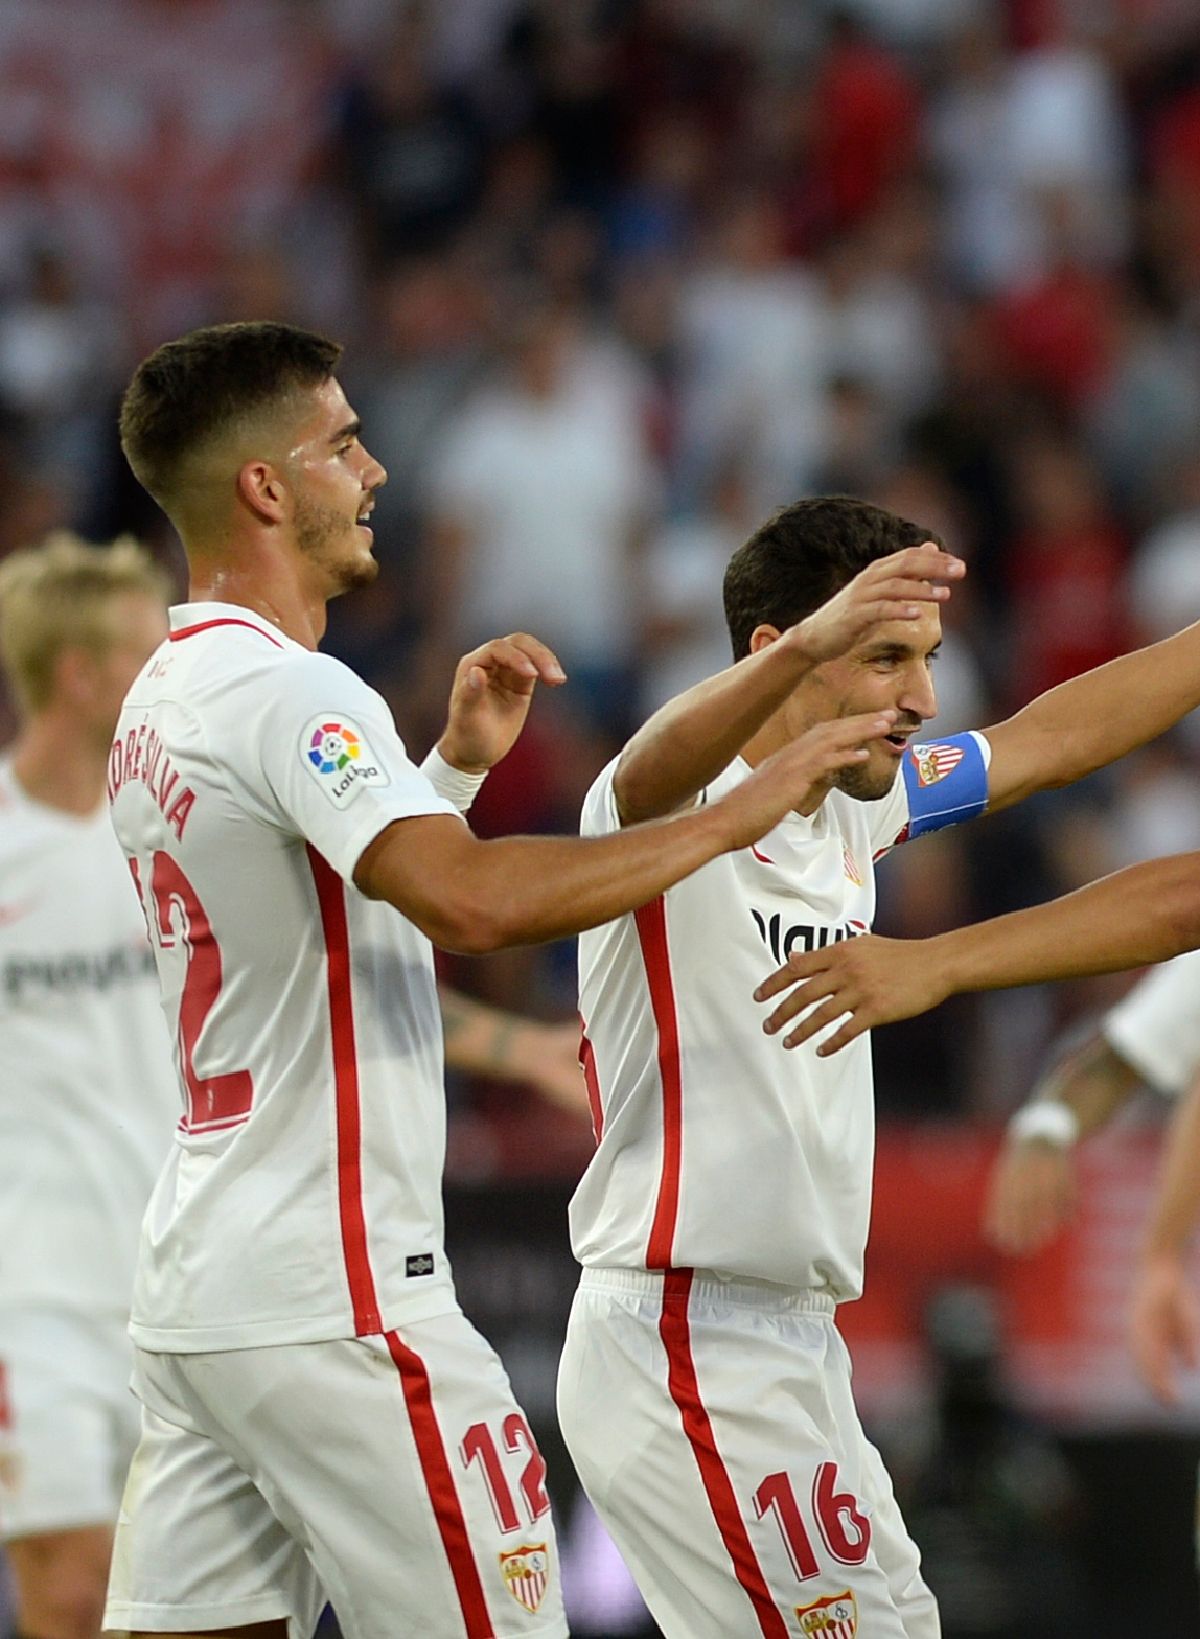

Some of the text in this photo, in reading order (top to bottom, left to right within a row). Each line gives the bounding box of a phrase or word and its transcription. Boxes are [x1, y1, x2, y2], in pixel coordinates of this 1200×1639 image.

[107, 711, 148, 806] DRÉ
[459, 1412, 551, 1536] 12
[752, 1460, 873, 1583] 16
